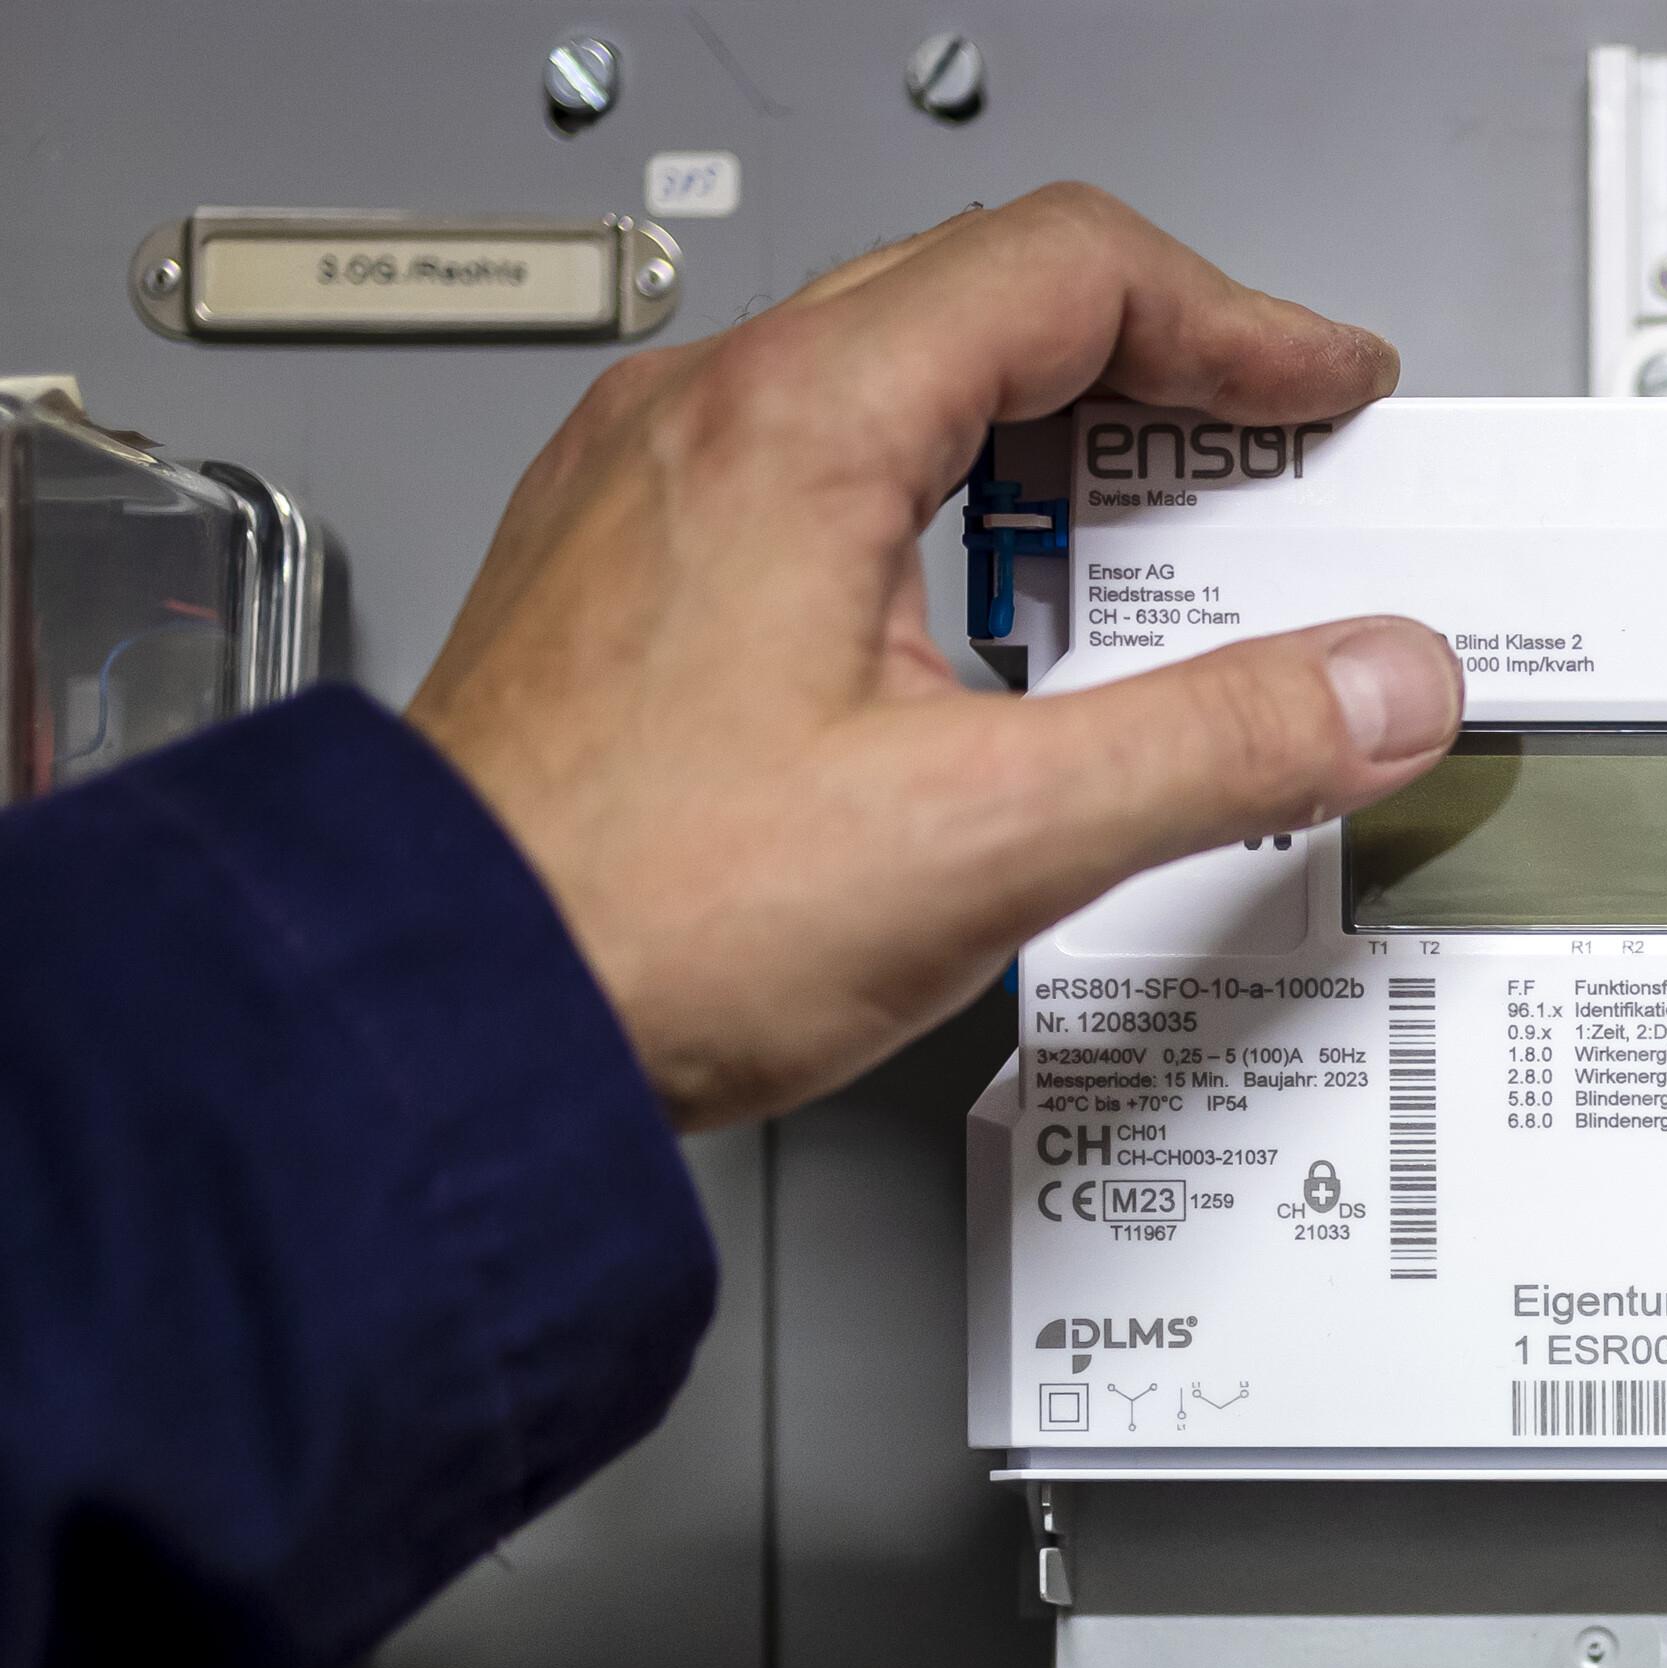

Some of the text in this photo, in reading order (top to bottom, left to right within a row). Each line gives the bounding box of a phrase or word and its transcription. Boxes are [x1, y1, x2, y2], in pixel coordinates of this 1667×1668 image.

[1086, 422, 1332, 479] ensor
[1088, 490, 1197, 506] Swiss Made
[1089, 564, 1174, 580] Ensor AG
[1089, 586, 1219, 602] Riedstrasse 11
[1089, 609, 1117, 624] CH
[1136, 609, 1180, 624] 6330
[1187, 609, 1240, 624] Cham
[1090, 631, 1164, 647] Schweiz
[1456, 634, 1582, 649] Blind Klasse 2
[1459, 656, 1594, 676] 1000 Imp/kvarh
[1369, 941, 1440, 954] T1 T2
[1572, 941, 1591, 953] R1
[1623, 941, 1644, 953] R2
[1036, 978, 1364, 999] eRS801-SFO-10-a-10002b
[1508, 980, 1535, 995] F.F
[1508, 1002, 1562, 1017] 96.1.x
[1037, 1012, 1197, 1032] Nr. 12083035
[1508, 1025, 1551, 1040] 0.9.x
[1576, 1024, 1629, 1042] 1:Zeit,
[1163, 1048, 1202, 1066] 0,25
[1226, 1048, 1236, 1064] 5
[1243, 1048, 1303, 1067] (100)A
[1320, 1048, 1366, 1063] 50Hz
[1509, 1047, 1552, 1062] 1.8.0
[1037, 1072, 1368, 1091] Messperiode: 15 Min. Baujahr: 2023
[1508, 1069, 1552, 1084] 2.8.0
[1037, 1096, 1248, 1112] -40°C bis +70°C IP54
[1509, 1091, 1552, 1106] 5.8.0
[1508, 1113, 1552, 1128] 6.8.0
[1037, 1125, 1165, 1165] CH CH01
[1118, 1149, 1278, 1165] CH-CH003-21037
[1112, 1189, 1175, 1213] M23
[1191, 1193, 1234, 1209] 1259
[1277, 1204, 1366, 1219] CH DS
[1110, 1225, 1350, 1241] T11967 21033
[1515, 1336, 1527, 1364] 1
